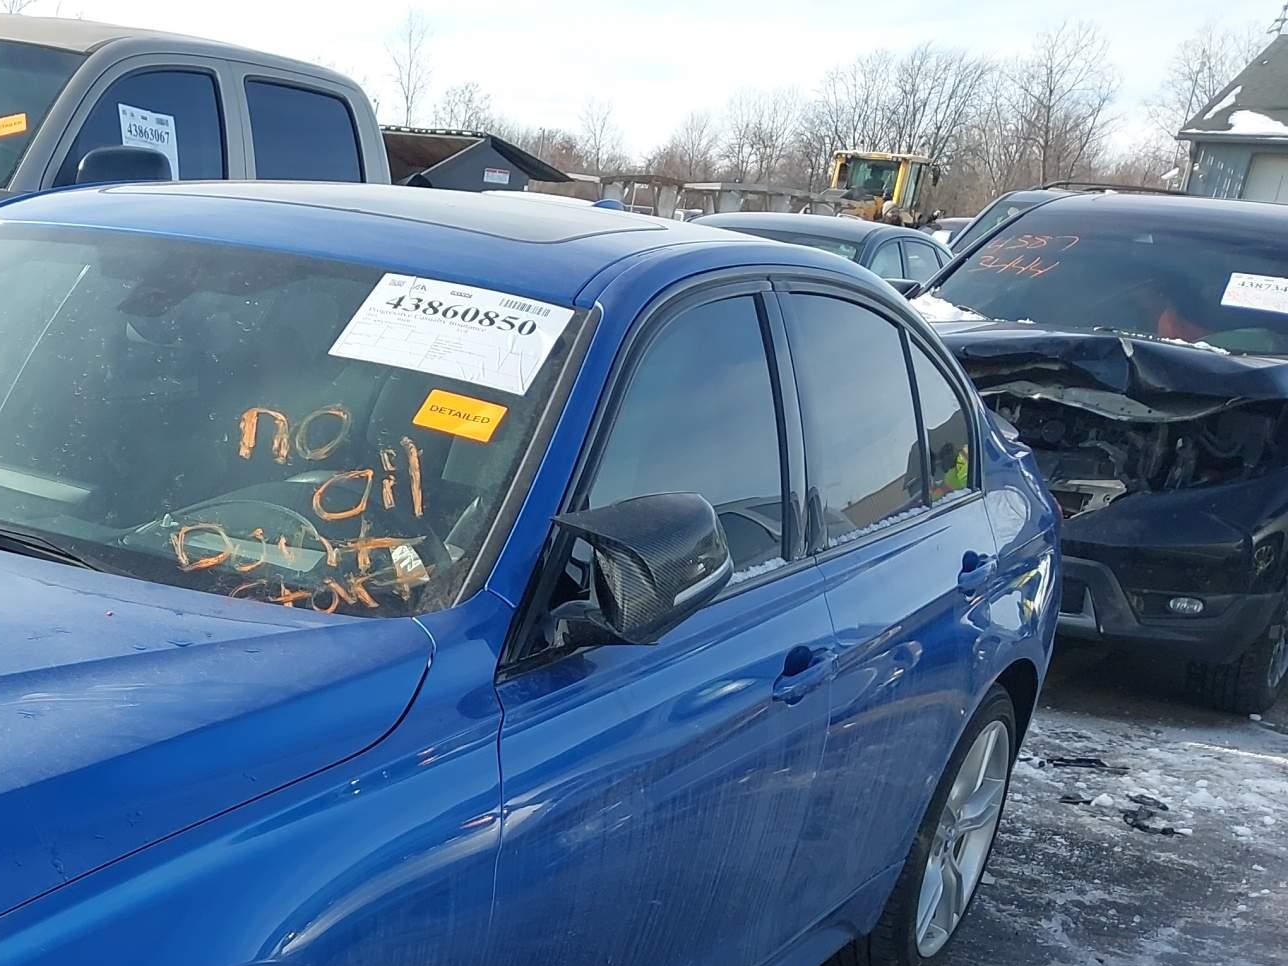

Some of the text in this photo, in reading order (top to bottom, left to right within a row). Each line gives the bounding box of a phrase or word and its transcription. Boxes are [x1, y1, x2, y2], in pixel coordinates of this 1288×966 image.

[127, 122, 170, 145] 43863067
[385, 295, 537, 336] 43860850
[429, 404, 491, 424] DETAILED
